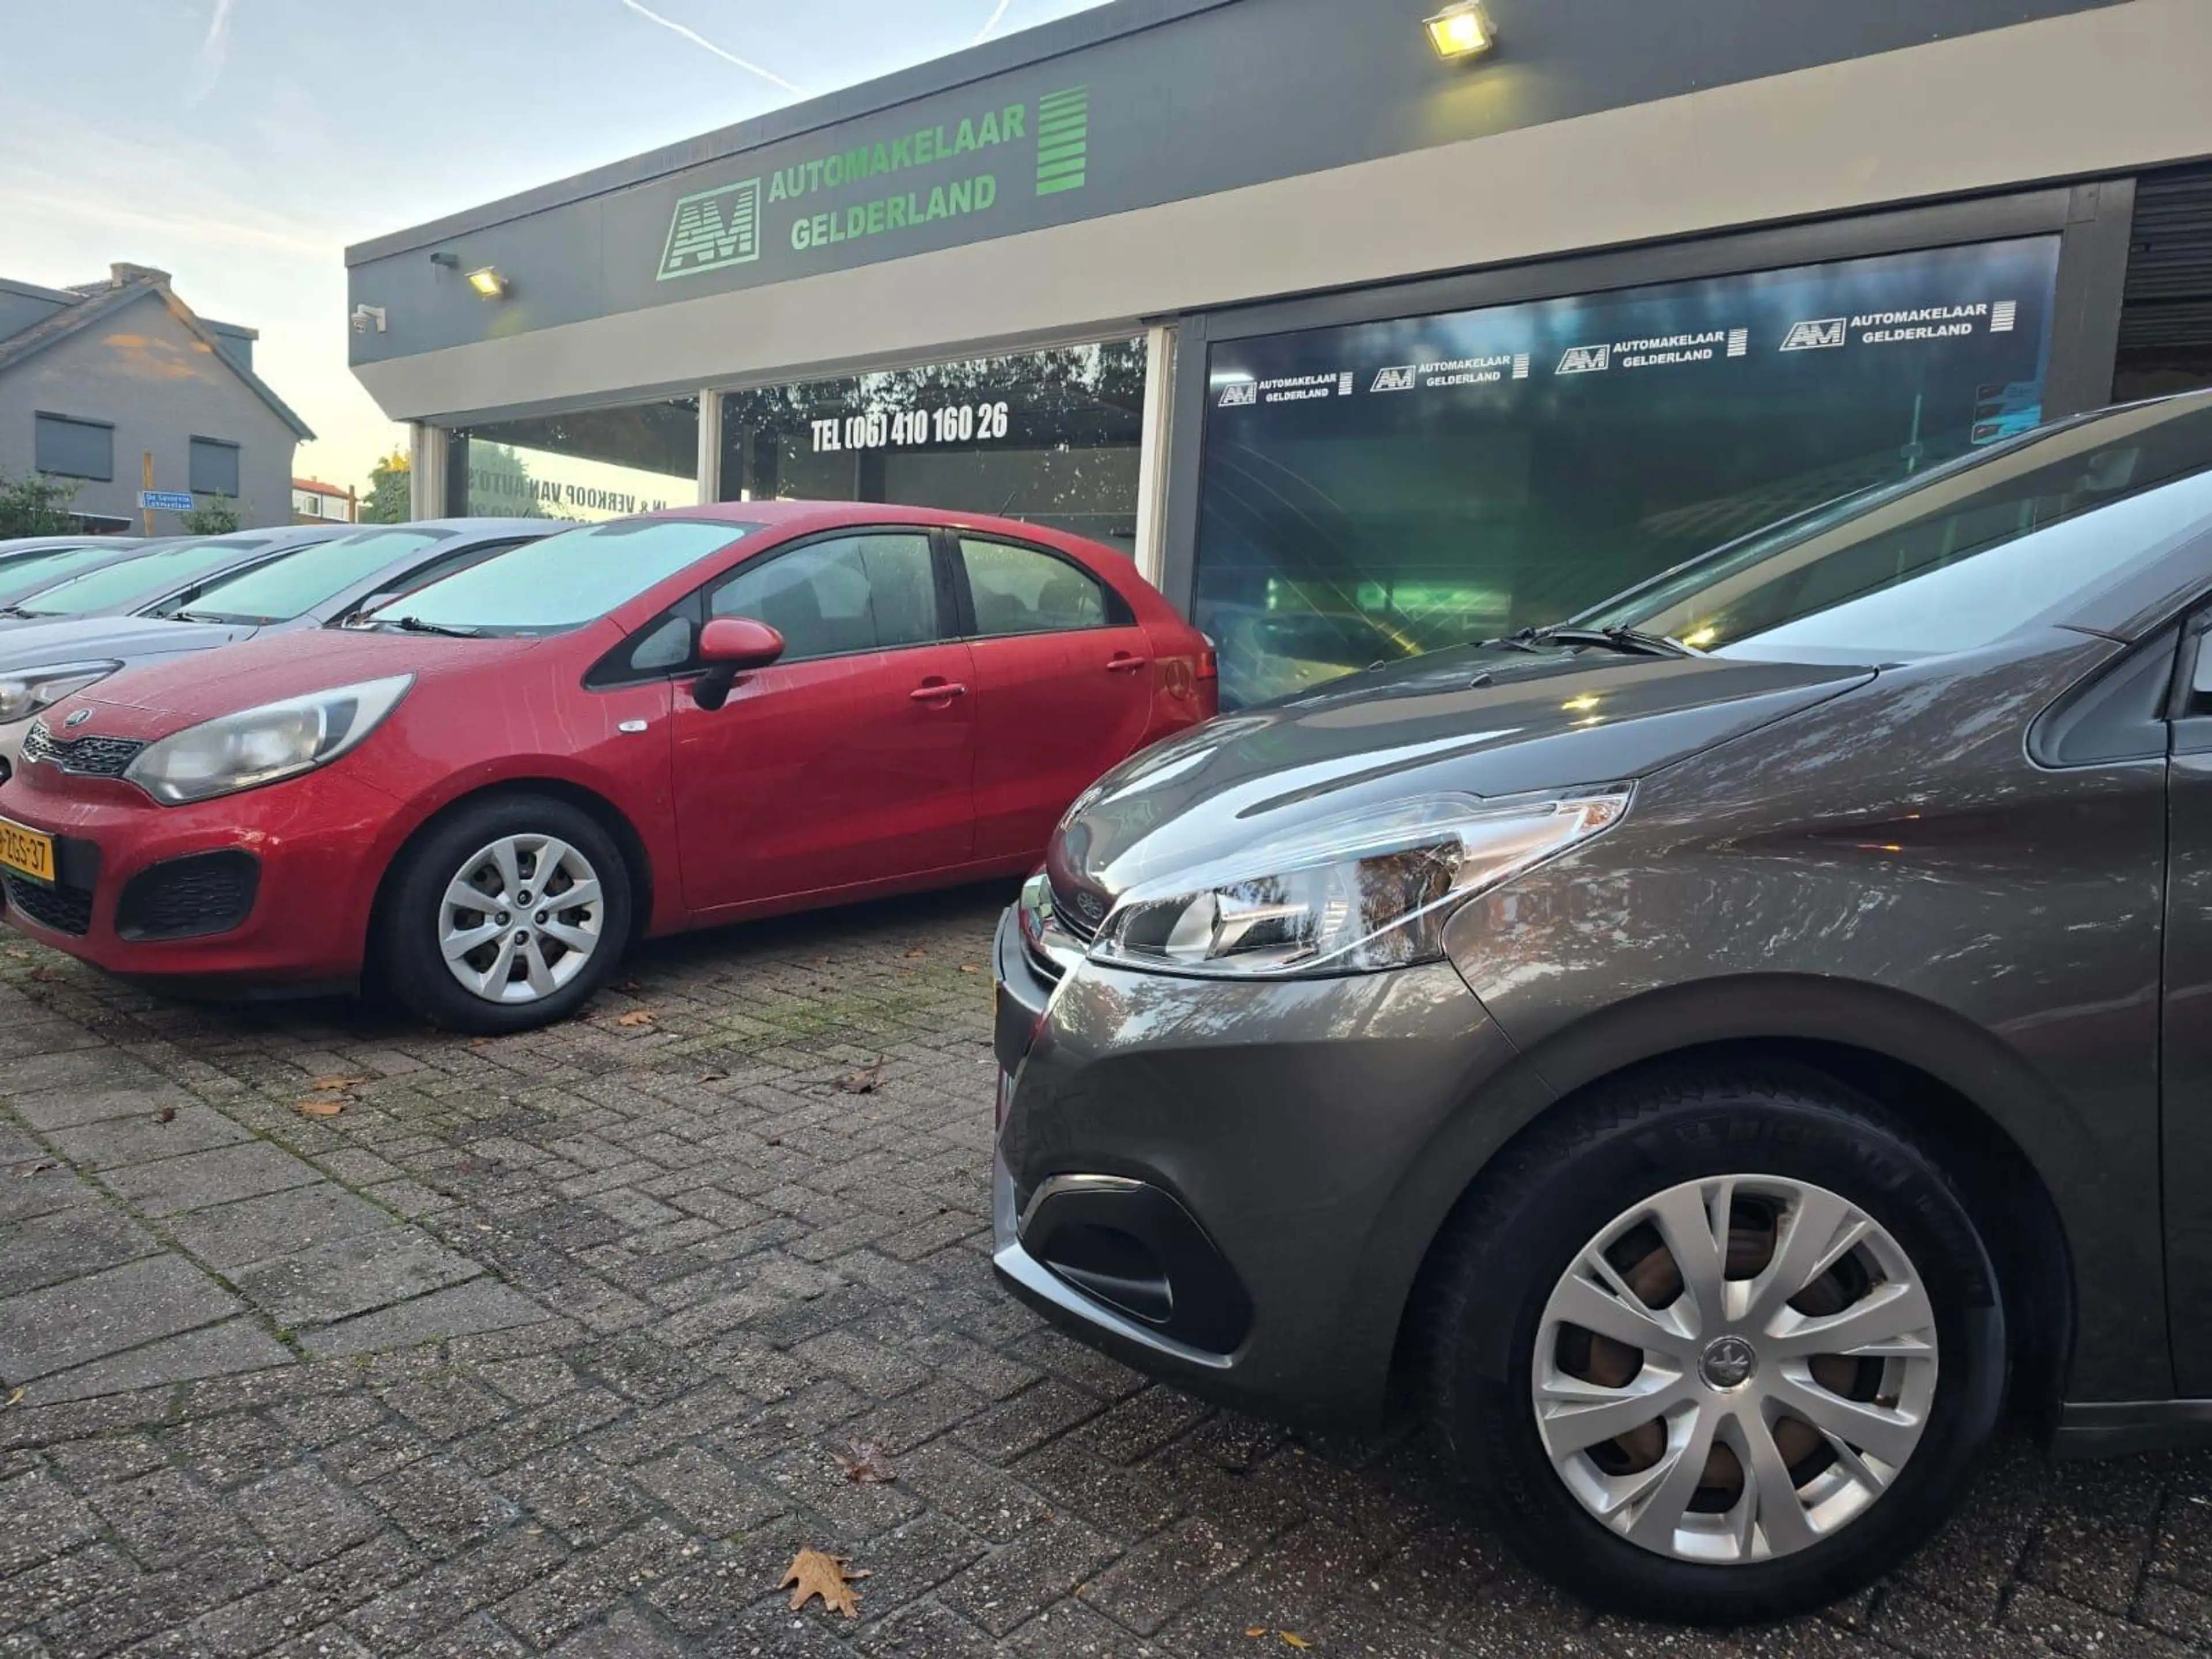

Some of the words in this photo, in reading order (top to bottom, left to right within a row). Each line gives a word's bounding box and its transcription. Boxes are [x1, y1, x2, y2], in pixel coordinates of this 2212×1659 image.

[768, 103, 1026, 203] AUTOMAKELAAR
[790, 175, 996, 251] GELDERLAND
[1850, 303, 1988, 328] AUTOMAKELAAR
[1613, 331, 1725, 353] AUTOMAKELAAR
[1862, 323, 1972, 343] GELDERLAND
[1419, 355, 1510, 374] AUTOMAKELAAR
[1622, 349, 1713, 368] GELDERLAND
[1259, 373, 1337, 390] AUTOMAKELAAR
[1426, 371, 1501, 387] GELDERLAND
[1265, 388, 1329, 402] GELDERLAND
[811, 418, 841, 452] TEL
[845, 415, 887, 450] (06)
[891, 409, 928, 445] 410
[933, 404, 973, 442] 160
[977, 402, 1008, 439] 26
